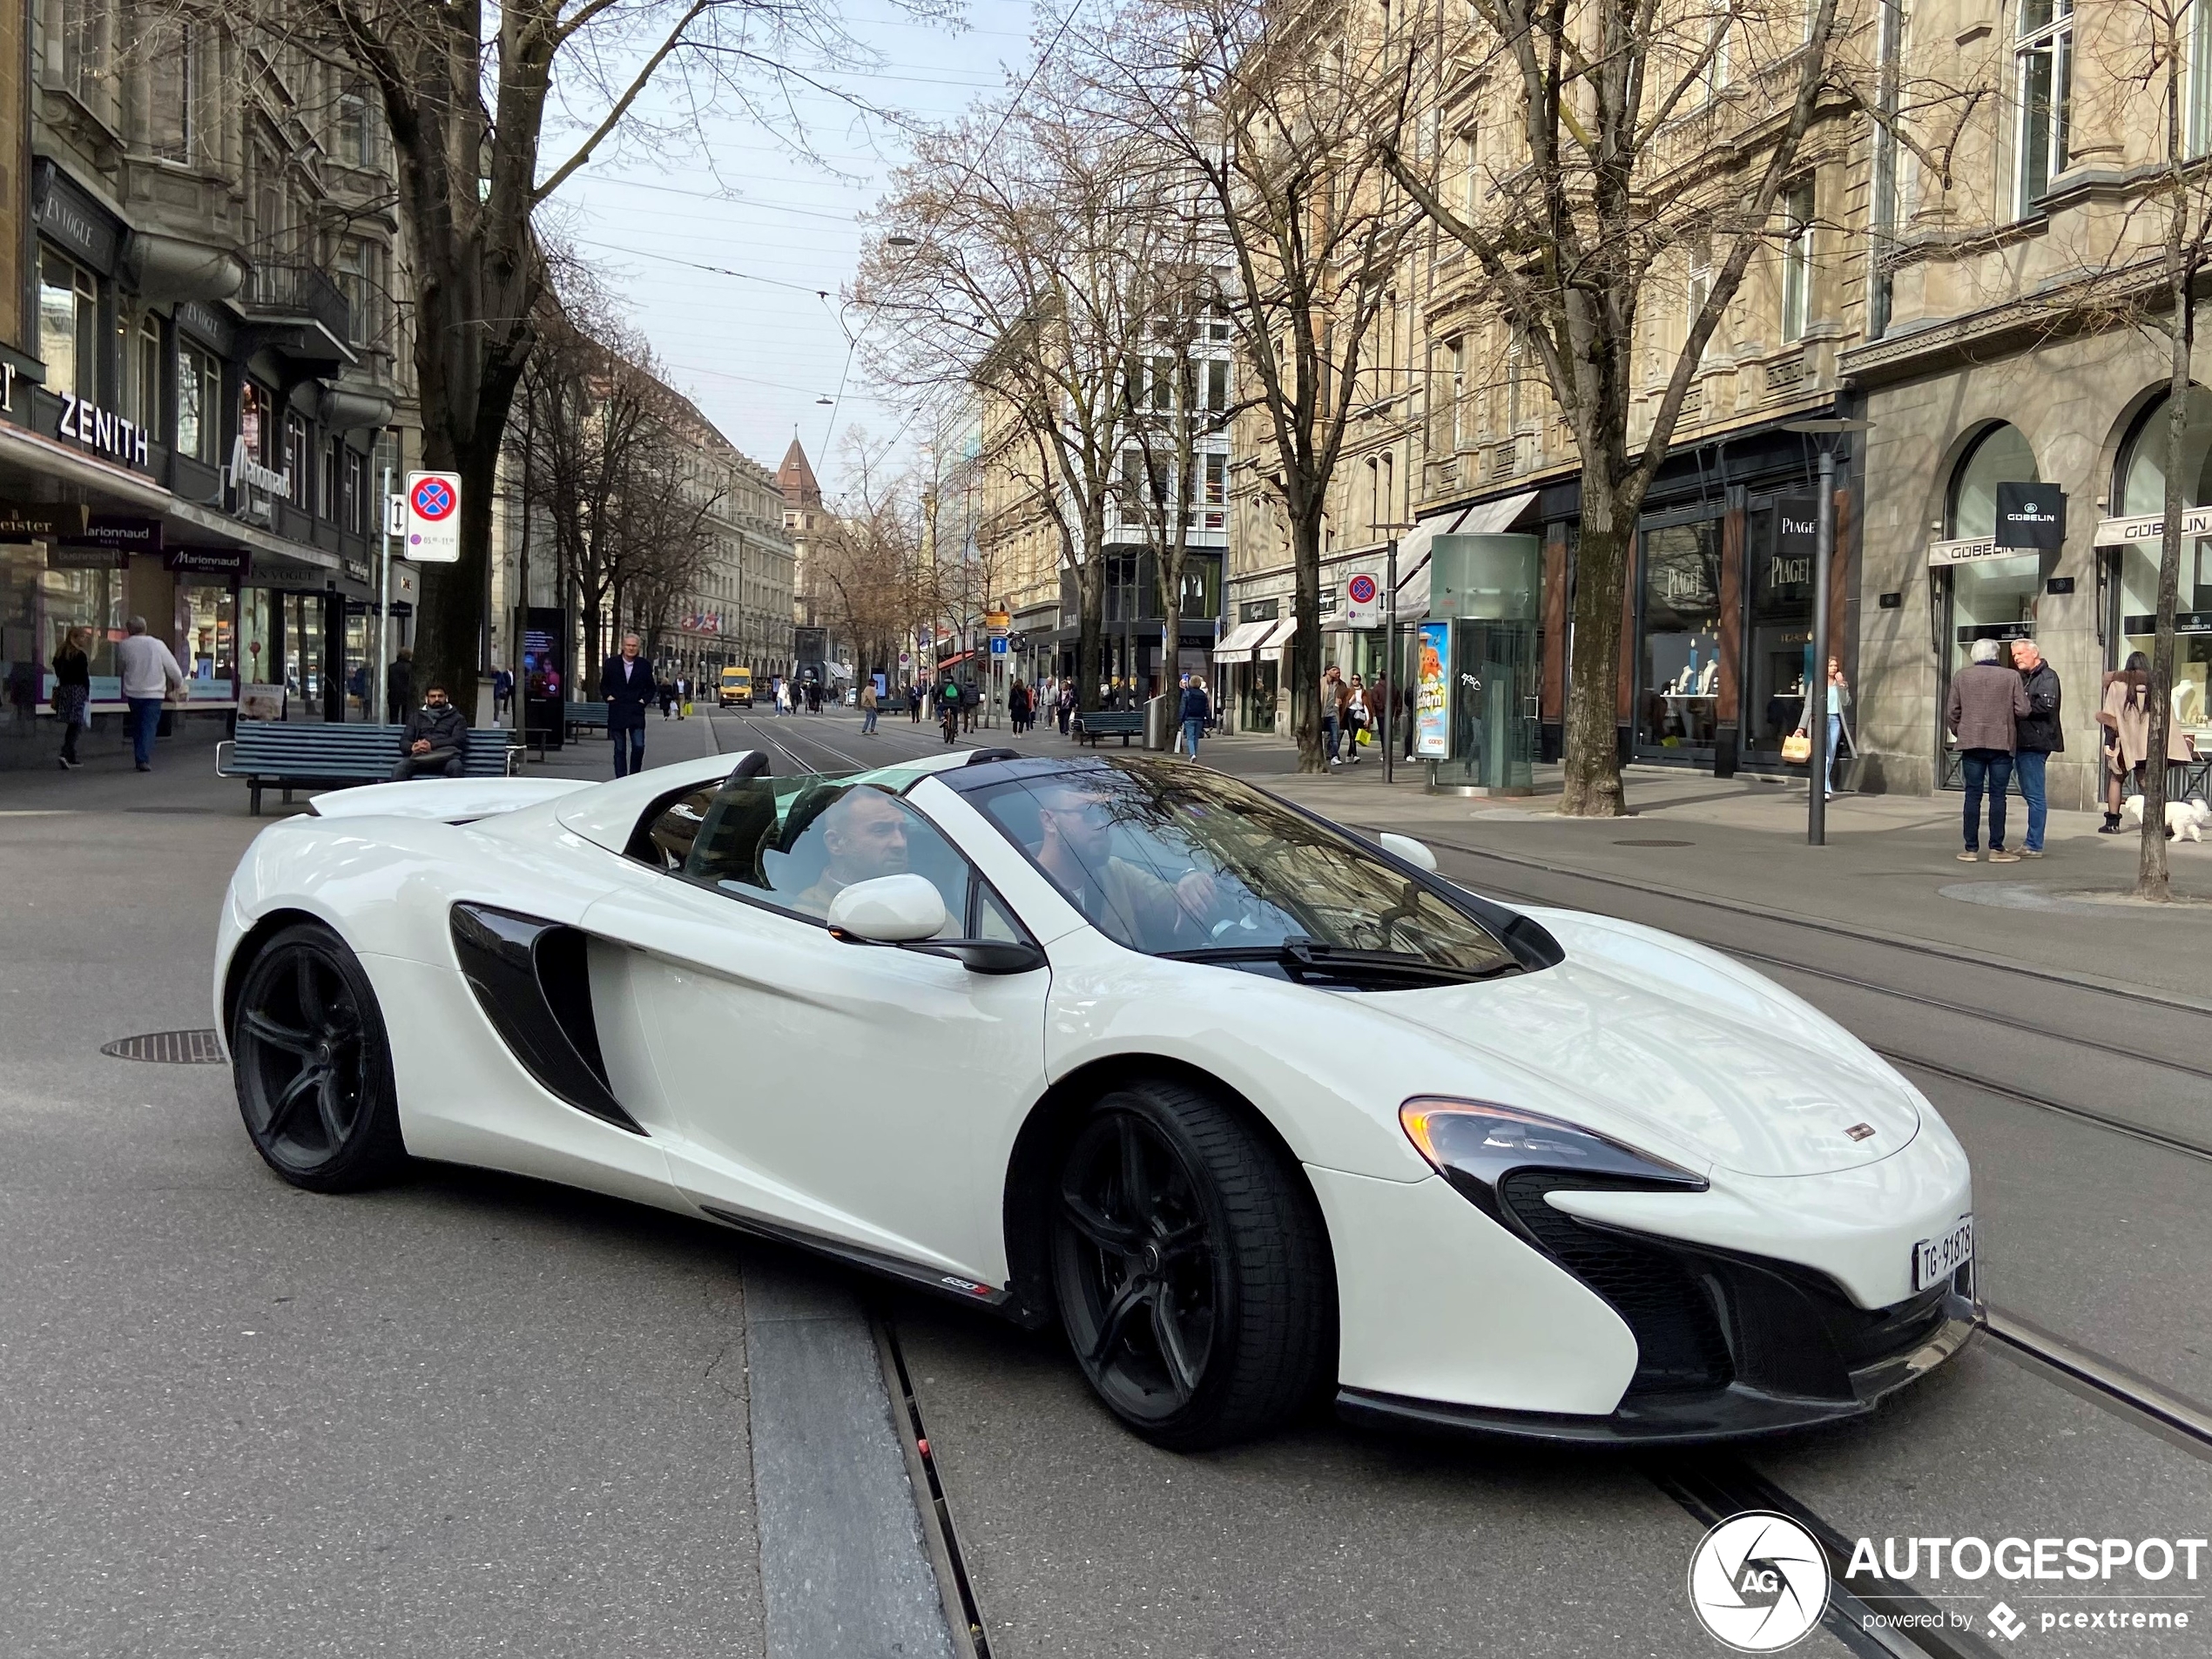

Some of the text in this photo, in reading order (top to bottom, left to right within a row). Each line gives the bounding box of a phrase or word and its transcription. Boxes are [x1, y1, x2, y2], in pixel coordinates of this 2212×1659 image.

[46, 197, 93, 247] EN VOGUE
[198, 310, 218, 339] VOGUE
[60, 392, 148, 467] ZENITH
[229, 434, 291, 499] Marionnaud
[1782, 517, 1817, 535] PIAGE
[2006, 513, 2055, 522] GÜBELIN
[84, 526, 149, 539] arionnaud
[172, 550, 239, 566] Marionnaud
[1667, 565, 1703, 597] PIAGET
